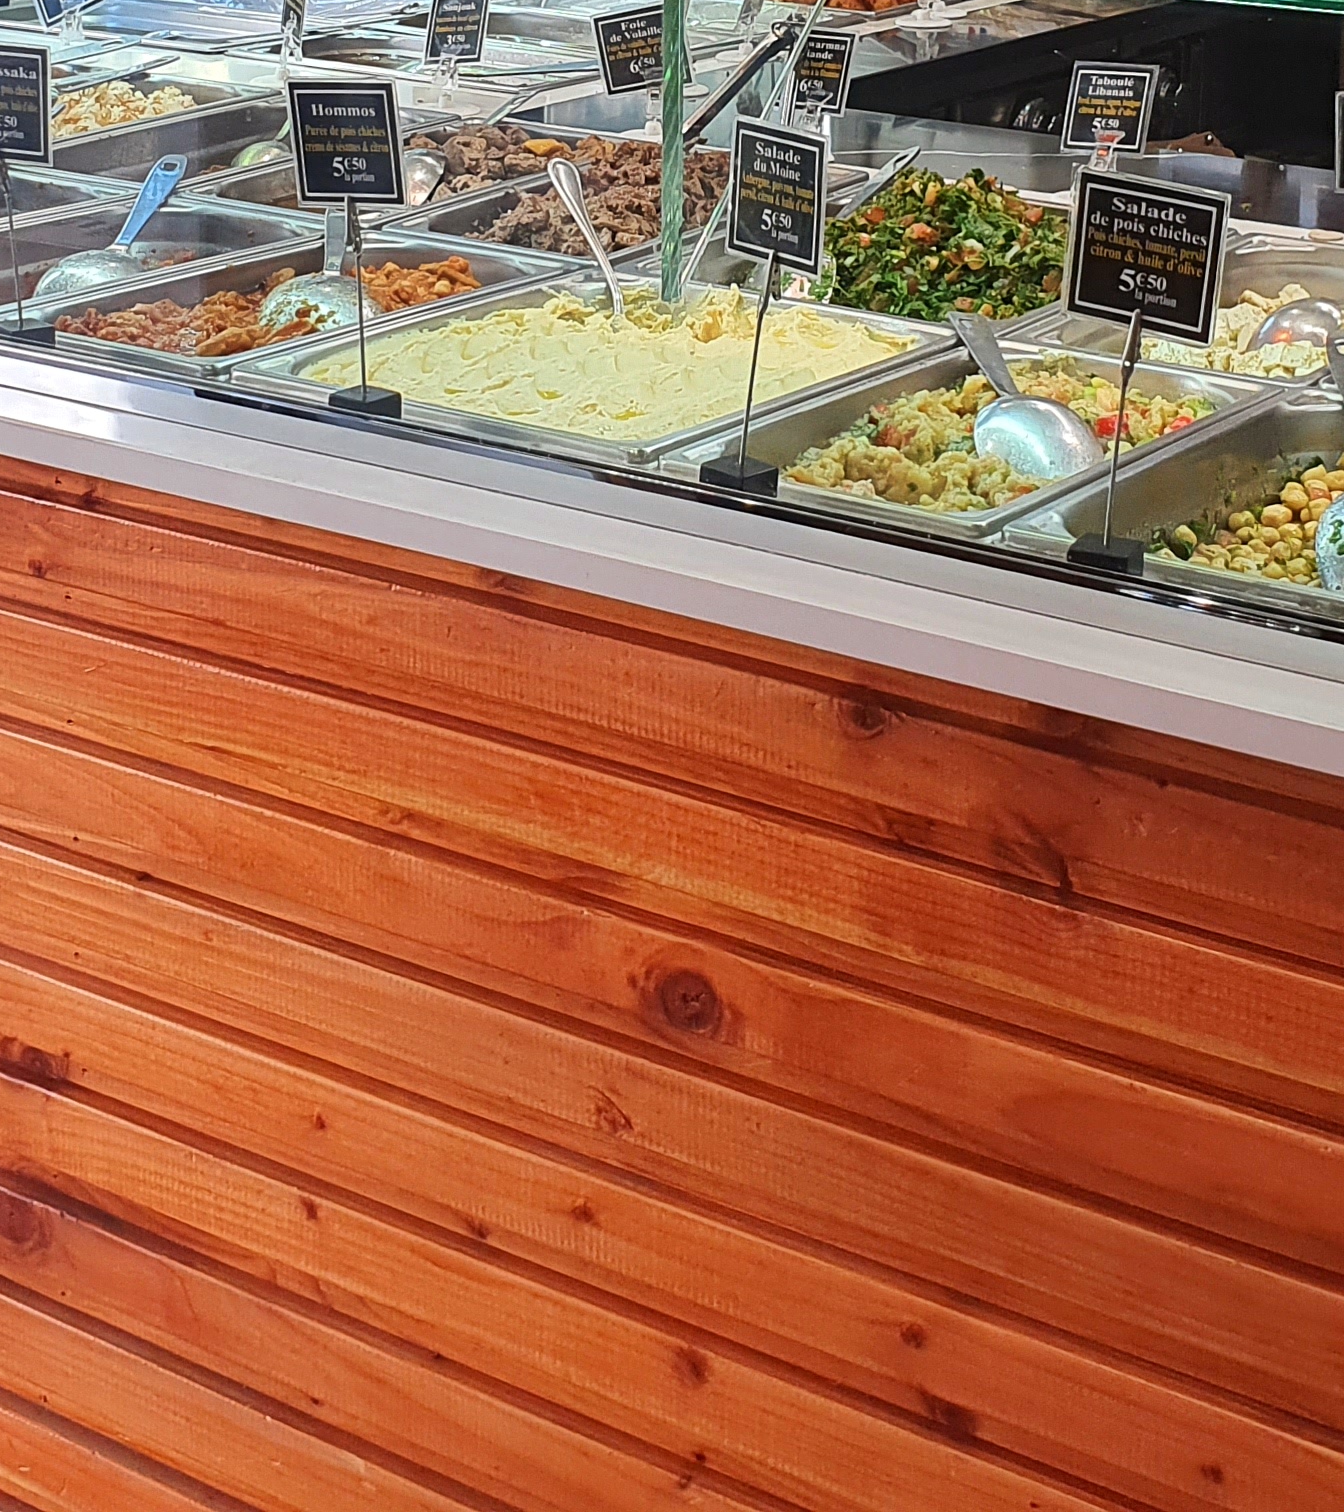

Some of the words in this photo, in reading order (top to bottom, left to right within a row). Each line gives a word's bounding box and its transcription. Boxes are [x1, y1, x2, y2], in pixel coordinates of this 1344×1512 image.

[610, 34, 622, 43] de
[624, 26, 663, 39] Volaille
[621, 19, 647, 31] Foie
[1088, 86, 1133, 97] Libanais
[1090, 76, 1134, 87] Taboulé
[311, 104, 376, 117] Hommos
[755, 141, 801, 165] Salade
[332, 156, 367, 177] 5€50
[754, 158, 767, 172] du
[769, 161, 801, 182] Moine
[761, 208, 792, 231] 5€50
[1111, 196, 1187, 224] Salade
[1088, 226, 1105, 240] Pois
[1090, 211, 1109, 226] de
[1113, 218, 1145, 235] pois
[1150, 224, 1207, 247] chiches
[1090, 243, 1122, 260] citron
[1124, 249, 1135, 263] &
[1138, 252, 1164, 270] huile
[1166, 258, 1203, 278] d'olive
[1118, 268, 1167, 292] 5€50
[1134, 288, 1142, 300] la
[1144, 293, 1177, 308] portion
